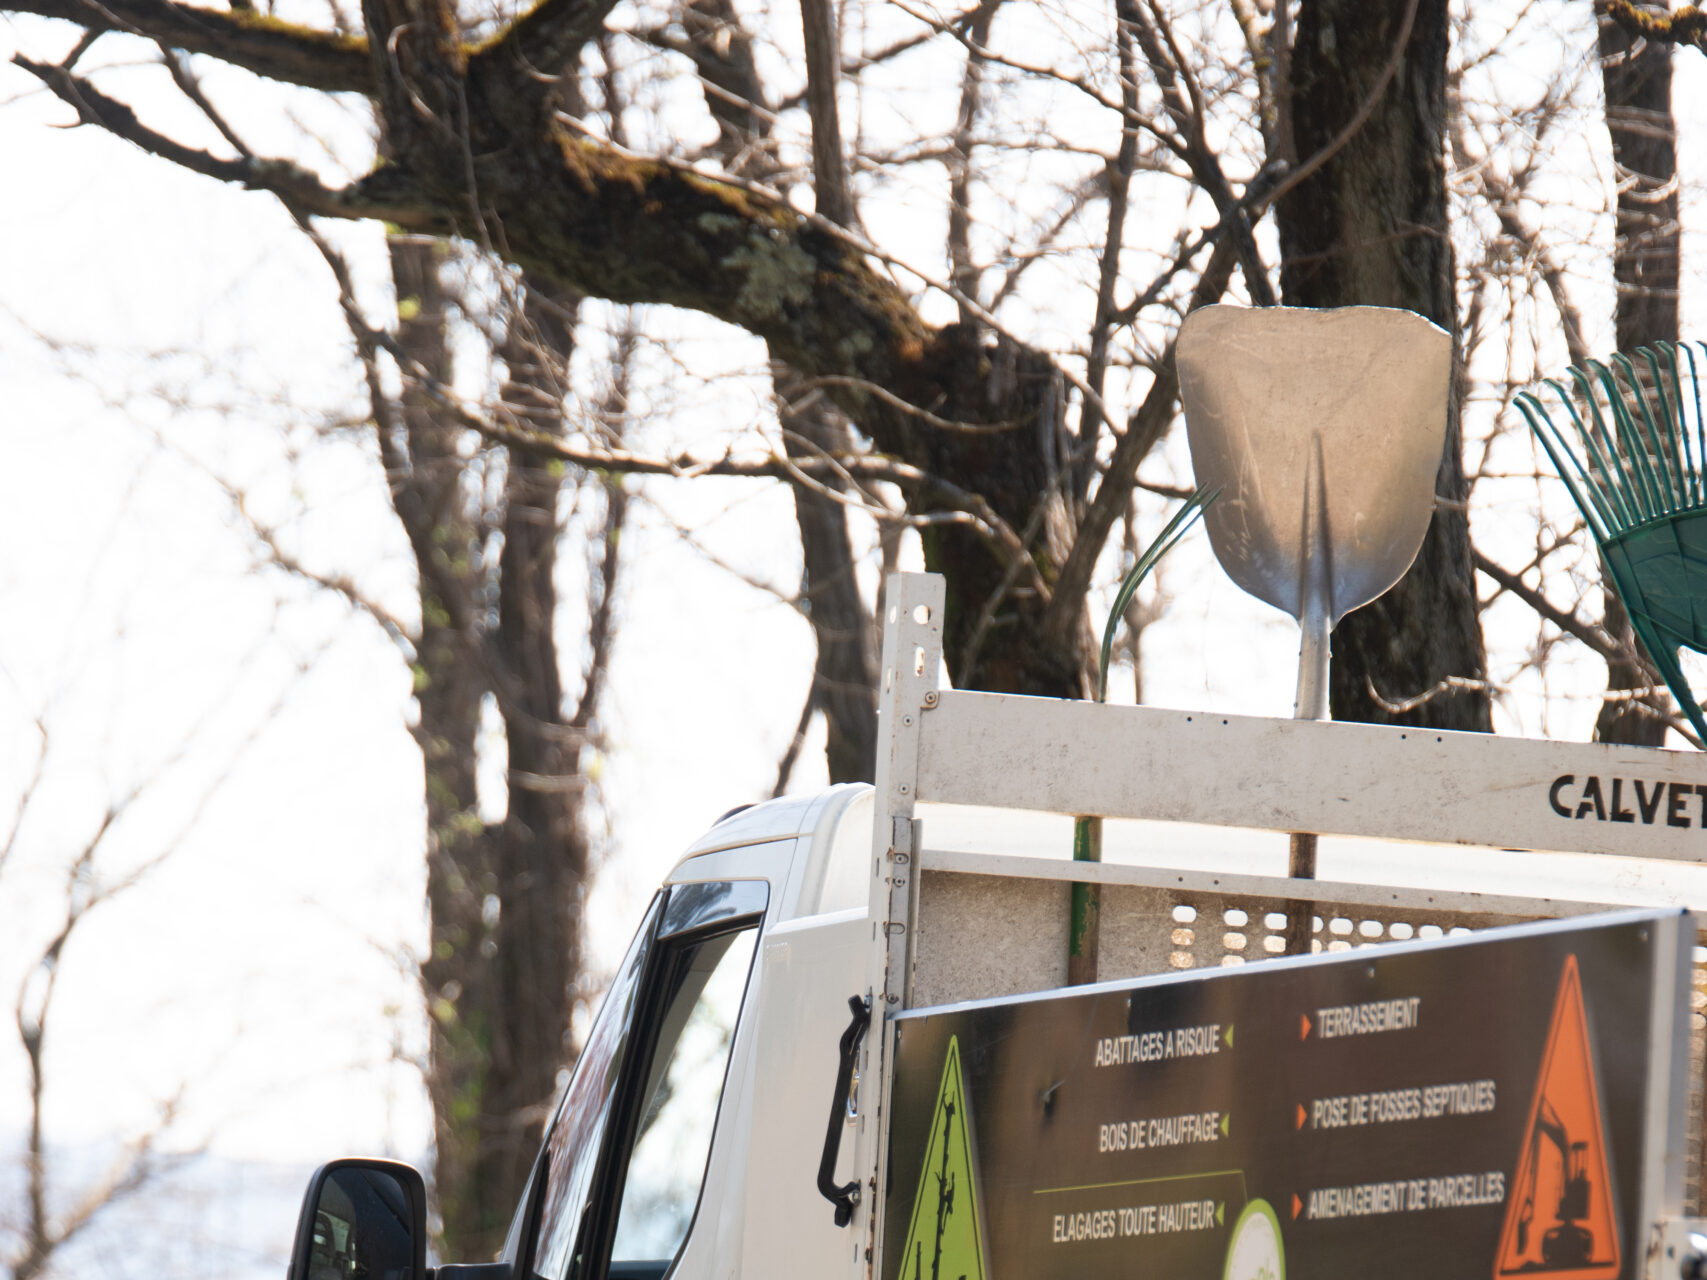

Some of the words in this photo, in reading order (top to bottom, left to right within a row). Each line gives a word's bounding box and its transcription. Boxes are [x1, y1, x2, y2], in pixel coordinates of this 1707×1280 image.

[1317, 997, 1421, 1038] TERRASSEMENT
[1095, 1031, 1164, 1068] ABATTAGES
[1165, 1031, 1174, 1058] A
[1176, 1024, 1221, 1057] RISQUE
[1313, 1097, 1349, 1129] POSE
[1351, 1094, 1369, 1126] DE
[1370, 1088, 1422, 1123] FOSSES
[1423, 1080, 1497, 1118] SEPTIQUES
[1100, 1122, 1128, 1153] BOIS
[1130, 1120, 1147, 1150] DE
[1149, 1112, 1220, 1148] CHAUFFAGE
[1308, 1181, 1407, 1220] AMENAGEMENT
[1408, 1179, 1427, 1210] DE
[1428, 1171, 1505, 1208] PARCELLES
[1053, 1210, 1116, 1243] ELAGAGES
[1118, 1206, 1158, 1237] TOUTE
[1159, 1200, 1215, 1233] HAUTEUR
